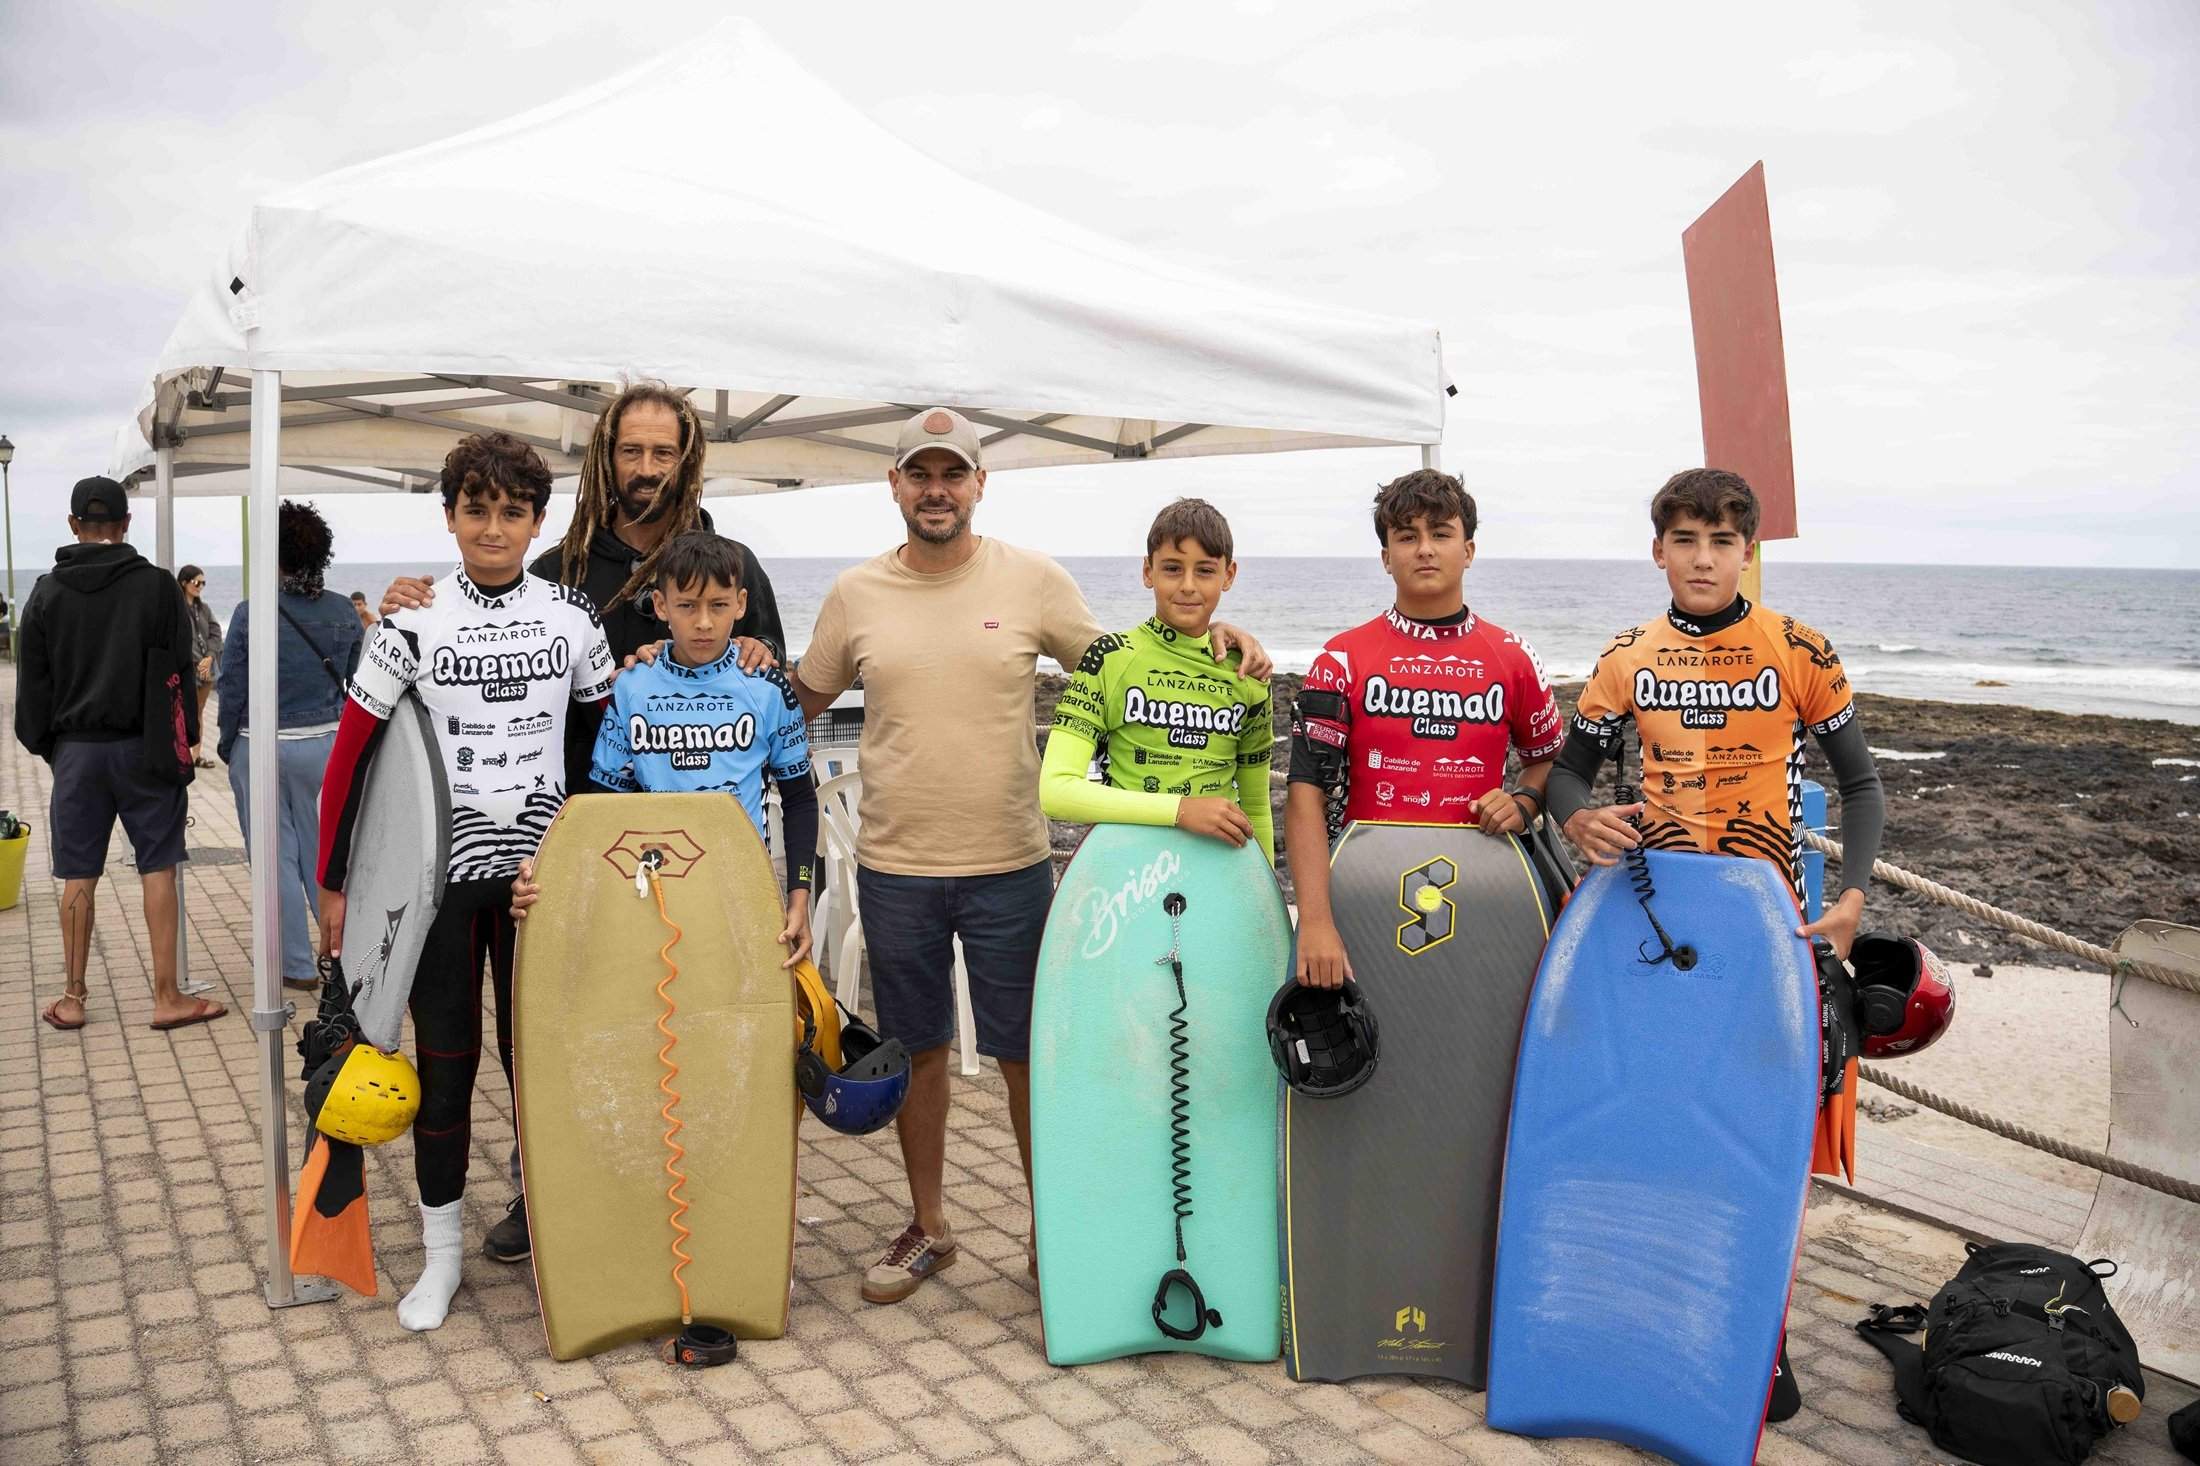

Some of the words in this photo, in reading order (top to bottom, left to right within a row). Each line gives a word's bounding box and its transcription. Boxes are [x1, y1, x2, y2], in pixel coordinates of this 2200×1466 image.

[457, 627, 547, 643] LANZAROTE
[1657, 654, 1754, 666] LANZAROTE
[1390, 664, 1484, 679] LANZAROTE
[483, 682, 527, 701] Class
[1147, 677, 1233, 696] LANZAROTE
[647, 702, 734, 712] LANZAROTE
[487, 721, 496, 730] de
[1681, 708, 1727, 728] Class
[1412, 717, 1457, 739] Class
[1168, 728, 1208, 749] Class
[671, 751, 711, 769] Class
[1383, 756, 1410, 765] Cabildo
[1383, 763, 1418, 772] Lanzarote
[1433, 764, 1484, 773] LANZAROTE
[1072, 850, 1180, 959] Brisa
